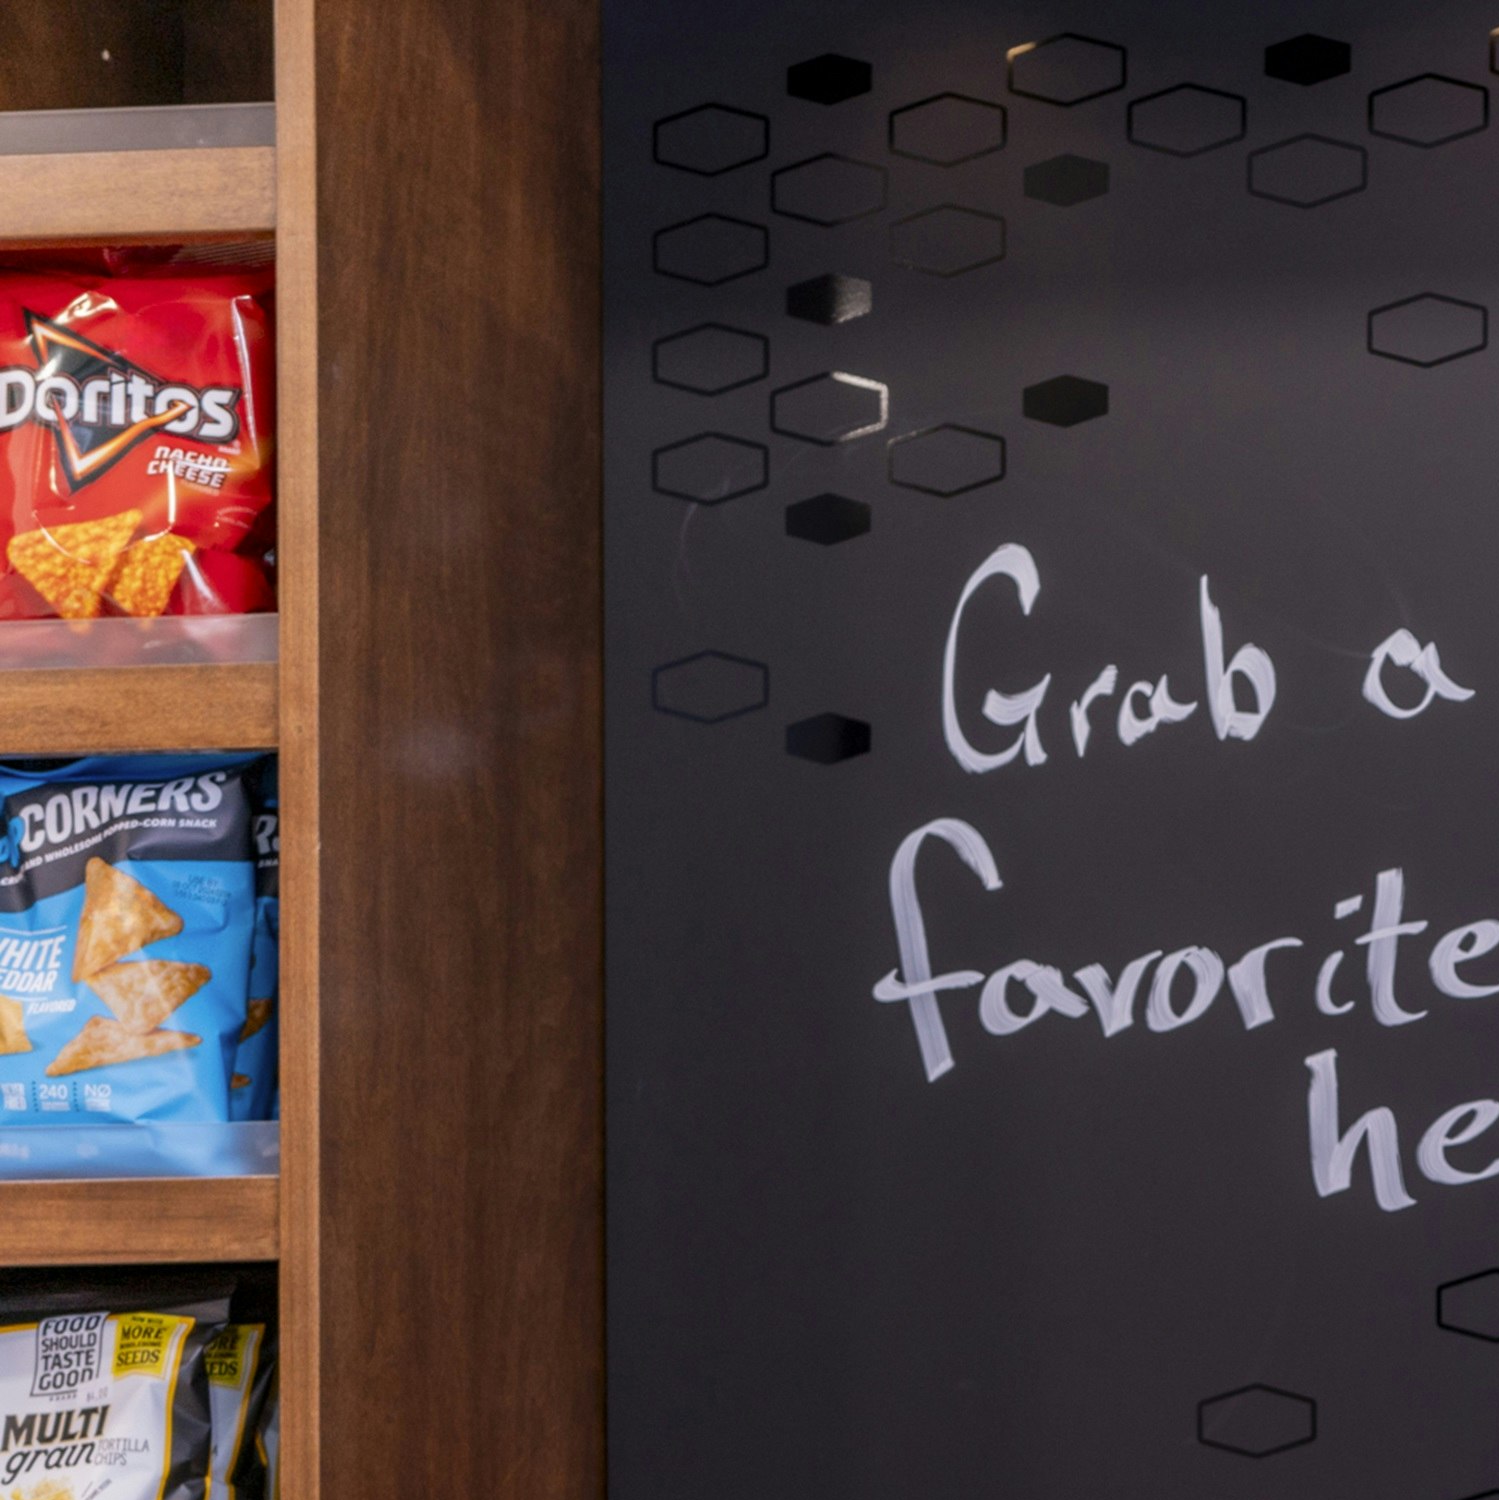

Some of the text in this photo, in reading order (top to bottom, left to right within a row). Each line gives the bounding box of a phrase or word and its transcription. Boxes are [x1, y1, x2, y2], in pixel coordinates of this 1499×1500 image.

[0, 366, 238, 443] Doritos
[154, 445, 228, 468] NACHO
[147, 460, 227, 489] CHEESE
[941, 542, 1277, 774] Grab
[1362, 628, 1475, 718] a
[178, 818, 217, 828] SNACK
[39, 1083, 69, 1100] 240
[43, 1315, 101, 1336] FOOD
[121, 1325, 165, 1341] MORE
[41, 1333, 97, 1353] SHOULD
[42, 1350, 95, 1372] TASTE
[116, 1350, 160, 1367] SEEDS
[39, 1368, 93, 1391] GOOD
[1, 1404, 111, 1451] MULTI
[98, 1437, 150, 1453] TORTILLA
[2, 1441, 96, 1485] grain
[95, 1453, 127, 1467] CHIPS
